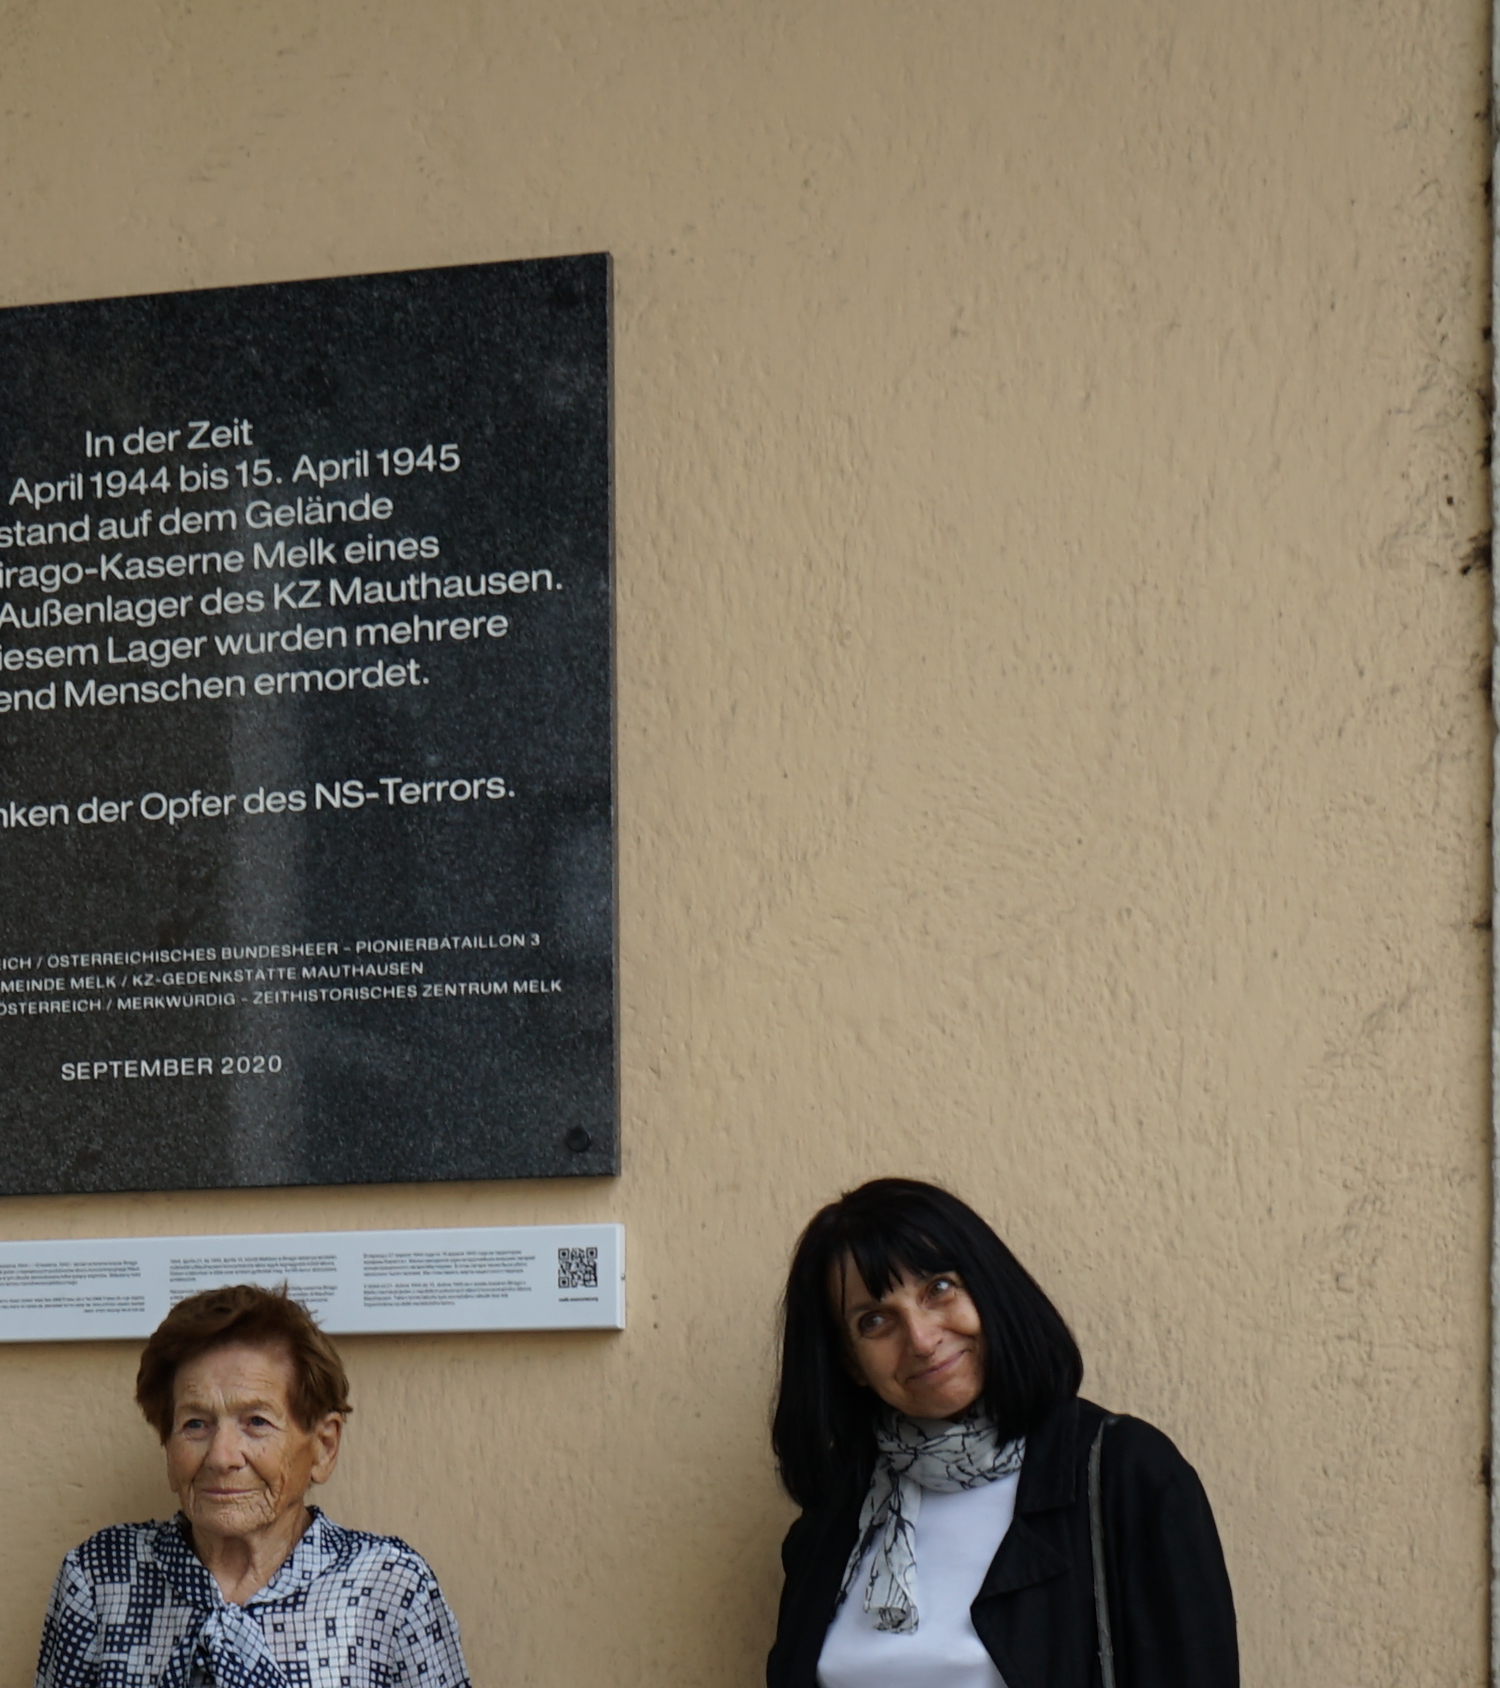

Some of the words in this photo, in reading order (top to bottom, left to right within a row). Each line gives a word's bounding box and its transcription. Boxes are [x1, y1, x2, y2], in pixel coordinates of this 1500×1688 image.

[85, 429, 115, 459] In
[122, 425, 182, 456] der
[186, 416, 254, 450] Zeit
[8, 472, 84, 511] April
[89, 465, 172, 500] 1944
[179, 461, 230, 493] bis
[234, 458, 283, 488] 15.
[291, 448, 370, 489] April
[375, 442, 461, 477] 1945
[97, 508, 153, 541] auf
[158, 506, 238, 537] dem
[244, 491, 394, 530] Gelände
[253, 536, 338, 570] Melk
[343, 532, 440, 565] eines
[199, 586, 266, 616] des
[273, 579, 322, 611] KZ
[329, 568, 563, 607] Mauthausen.
[107, 635, 208, 669] Lager
[213, 622, 348, 657] wurden
[355, 613, 509, 647] mehrere
[64, 672, 246, 709] Menschen
[253, 657, 430, 696] ermordet.
[76, 795, 135, 824] der
[139, 789, 237, 826] Opfer
[242, 785, 307, 815] des
[314, 776, 516, 810] NS-Terrors.
[46, 947, 217, 969] ÖSTERREICHISCHES
[221, 941, 339, 961] BUNDESHEER
[355, 933, 526, 954] PIONIERBATAILLON
[530, 932, 541, 947] 3
[69, 975, 117, 990] MELK
[301, 961, 424, 980] MAUTHAUSEN
[116, 992, 236, 1011] MERKWÜRDIG
[252, 984, 418, 1005] ZEITHISTORISCHES
[421, 980, 509, 998] ZENTRUM
[512, 978, 563, 994] MELK
[61, 1057, 213, 1082] SEPTEMBER
[220, 1054, 282, 1075] 2020
